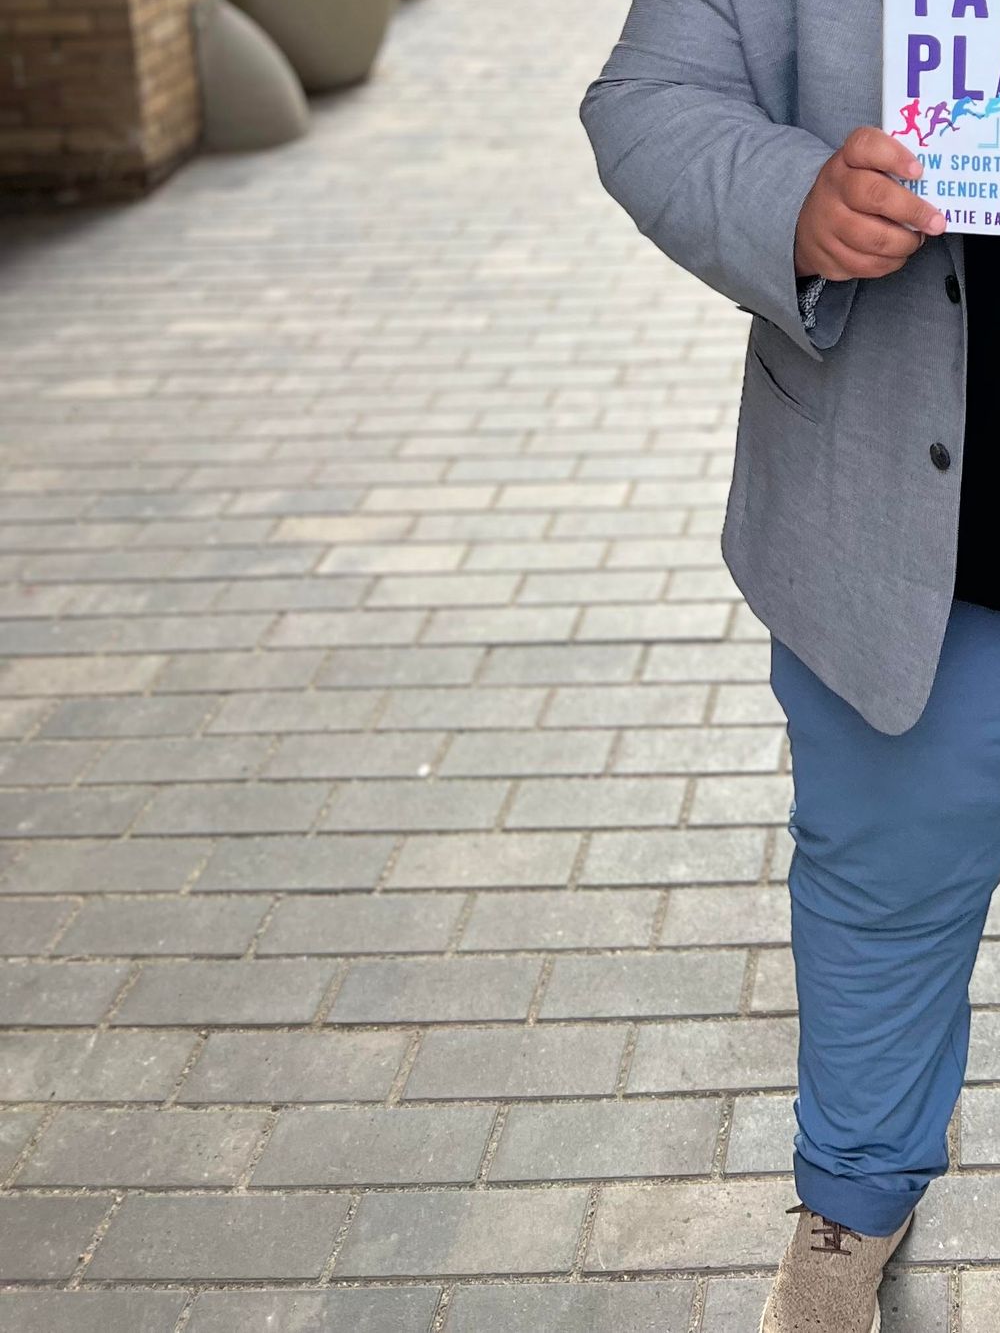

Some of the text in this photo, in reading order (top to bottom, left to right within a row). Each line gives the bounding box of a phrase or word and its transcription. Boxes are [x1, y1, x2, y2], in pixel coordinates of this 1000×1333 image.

[916, 153, 942, 170] OW
[937, 180, 998, 199] GENDER
[938, 208, 977, 224] ATIE
